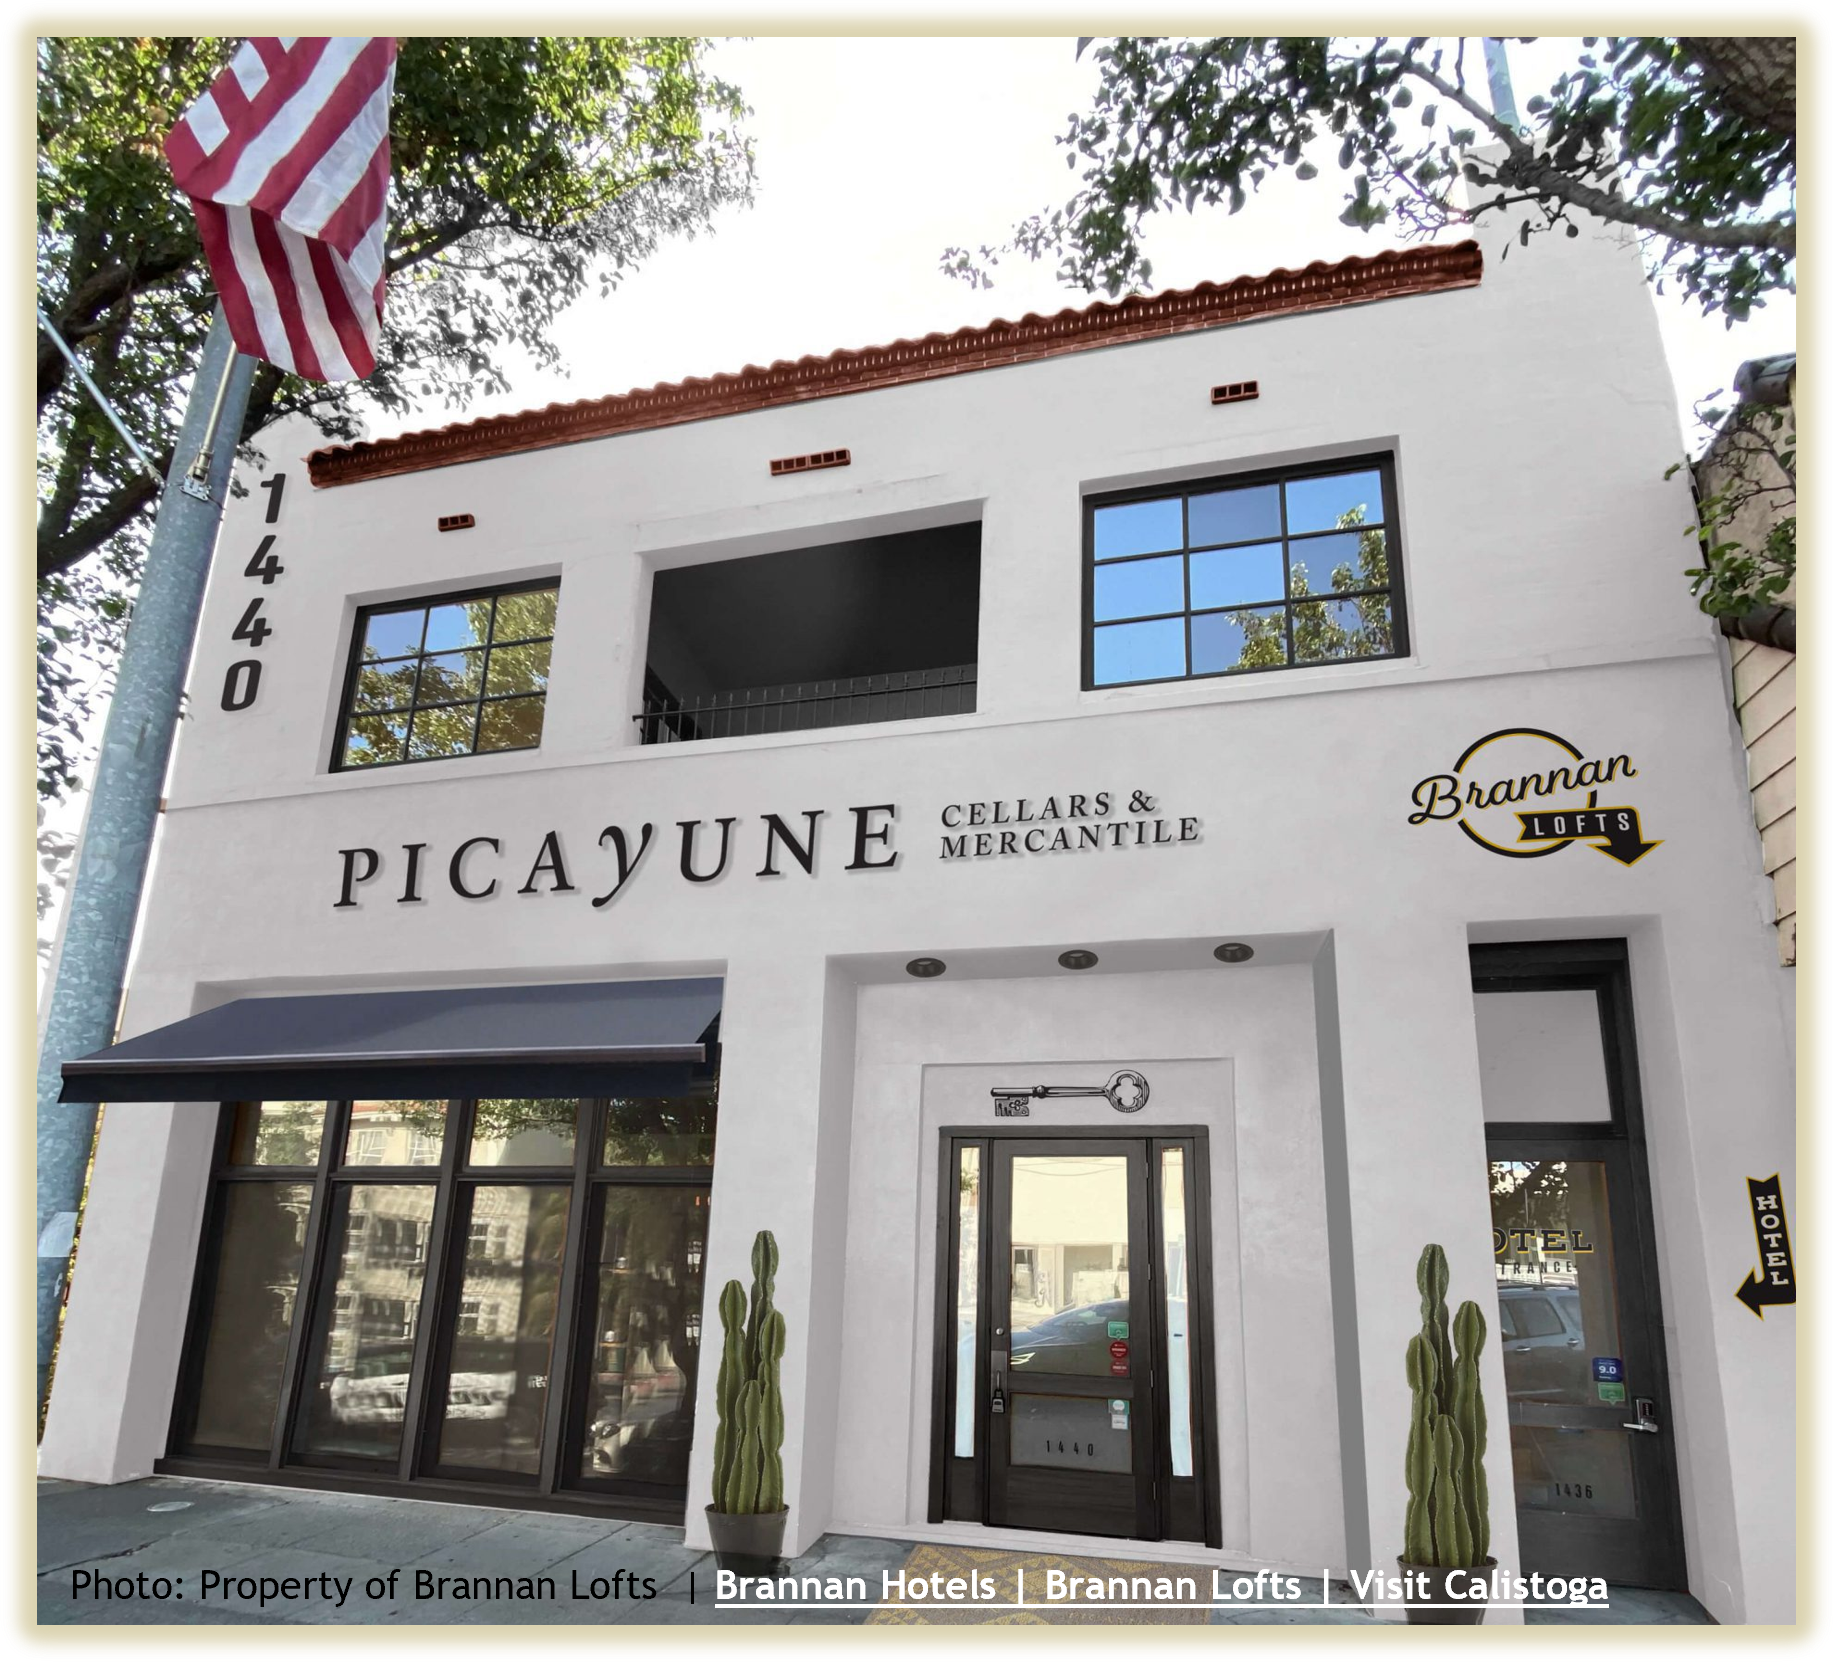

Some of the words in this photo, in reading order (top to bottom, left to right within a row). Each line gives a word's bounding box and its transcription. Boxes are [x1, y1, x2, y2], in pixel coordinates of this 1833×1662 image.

[220, 473, 286, 712] 1440
[1407, 754, 1638, 826] Brannan
[941, 792, 1110, 828] CELLARS
[1128, 789, 1156, 813] &
[1533, 812, 1631, 836] LOFTS
[939, 817, 1199, 859] MERCANTILE
[1493, 1227, 1594, 1254] OTEL
[1756, 1194, 1790, 1286] HOTEL
[1499, 1260, 1573, 1275] TRANCE
[1598, 1365, 1617, 1375] 9.0
[1046, 1439, 1094, 1457] 1440
[1555, 1482, 1593, 1499] 1436
